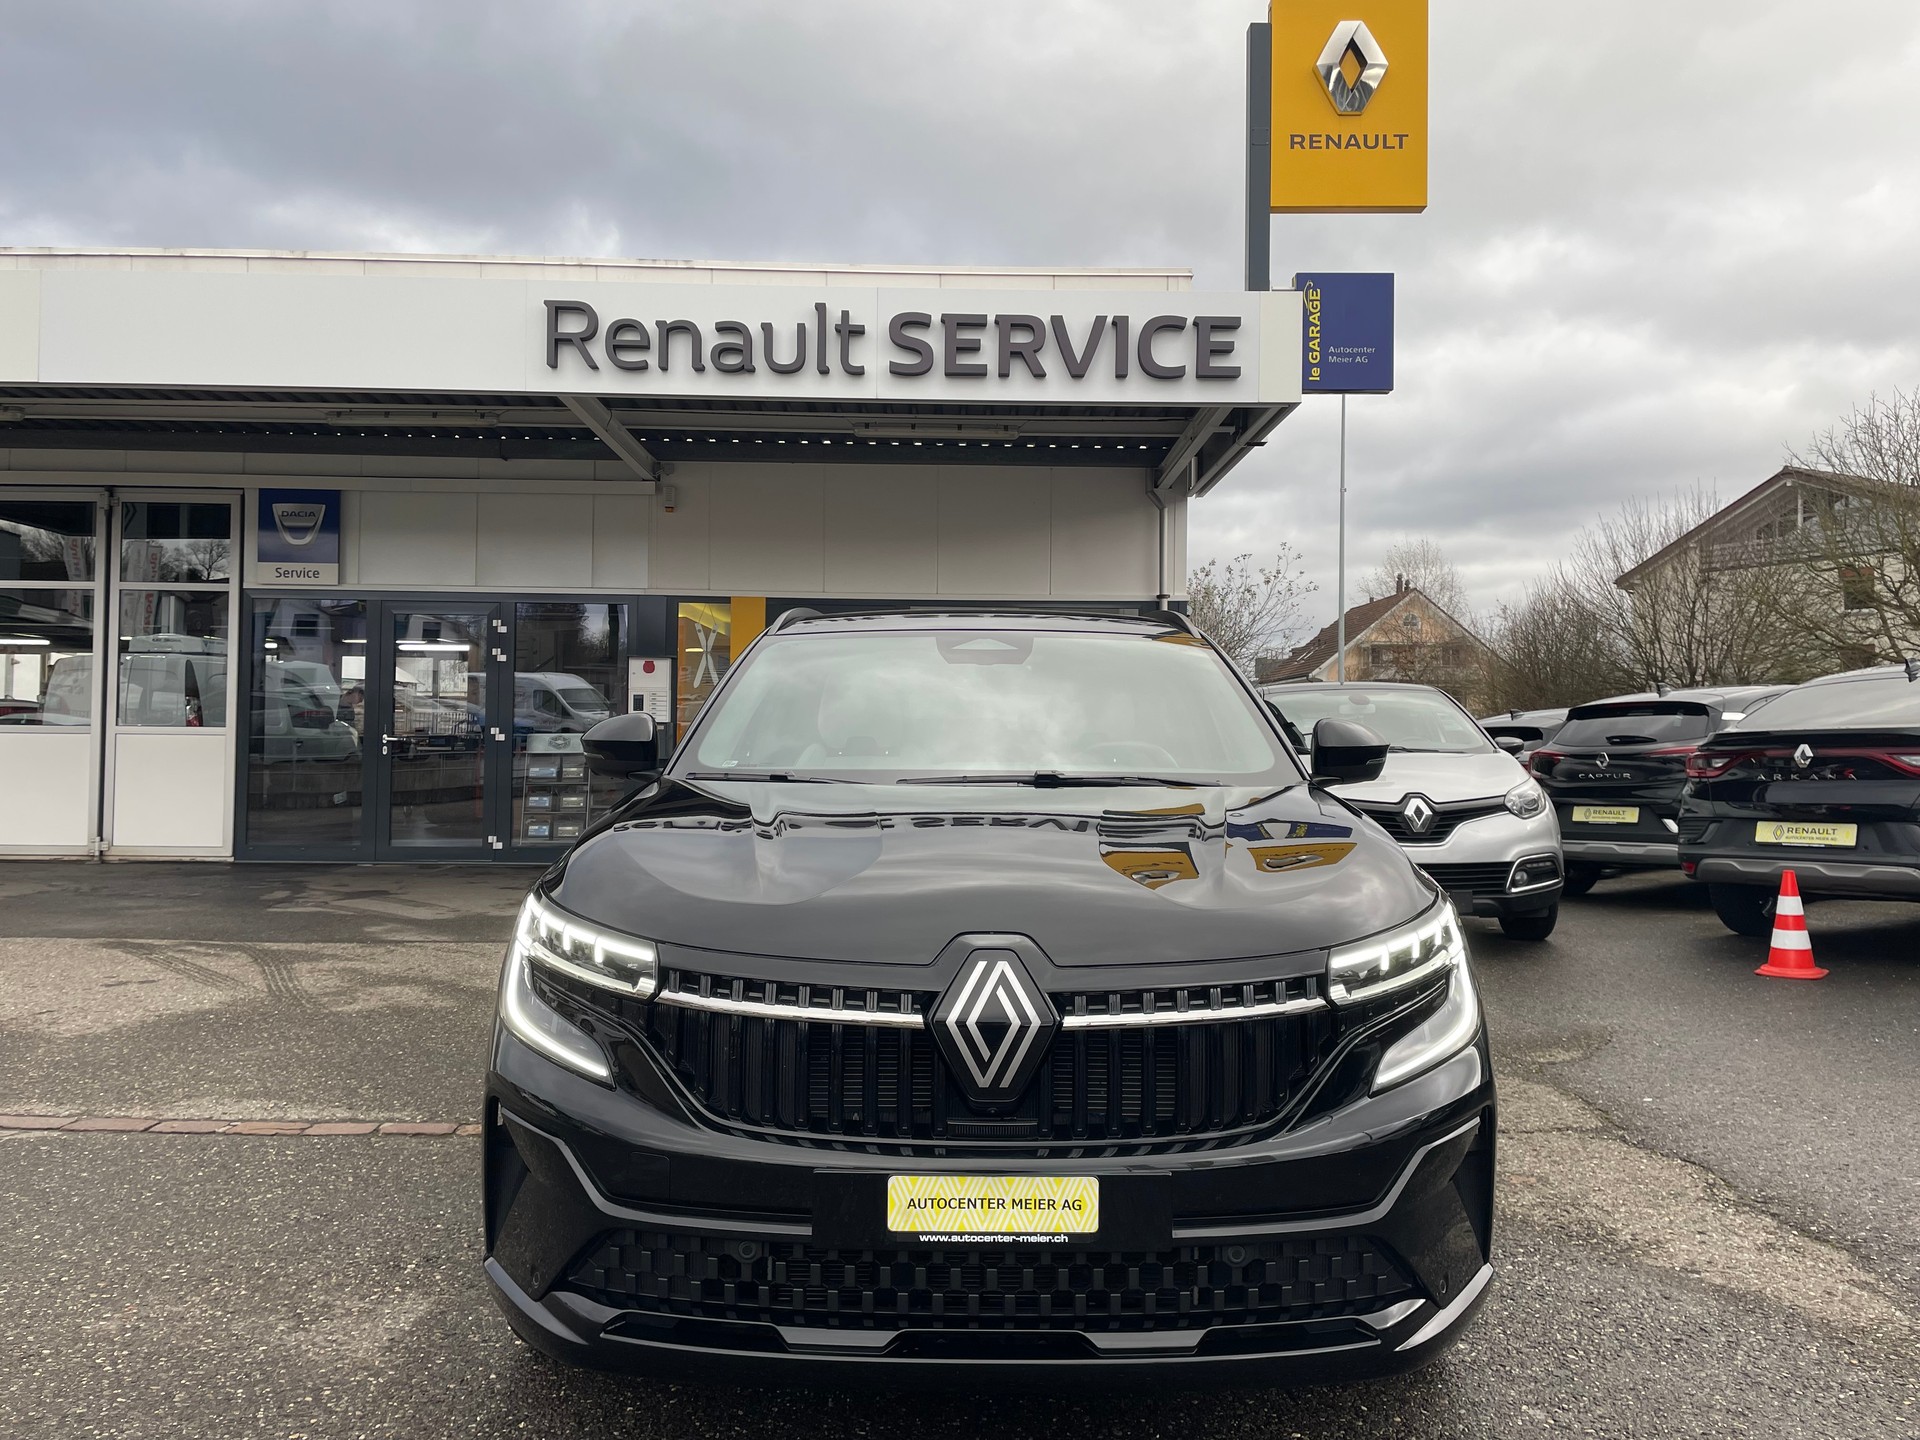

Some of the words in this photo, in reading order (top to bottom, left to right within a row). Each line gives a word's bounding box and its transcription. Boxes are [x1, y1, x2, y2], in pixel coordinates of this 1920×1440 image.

[1290, 134, 1409, 149] RENAULT
[1308, 288, 1321, 364] GARAGE
[543, 299, 866, 376] Renault
[888, 311, 1242, 380] SERVICE
[1328, 346, 1376, 354] Autocenter
[1328, 355, 1353, 363] Meier
[1355, 355, 1369, 363] AG
[1308, 367, 1321, 381] le
[281, 510, 316, 518] DACIA
[275, 567, 320, 579] Service
[1578, 772, 1632, 780] CAPTUR
[1757, 773, 1857, 781] ARKANA
[1787, 827, 1838, 835] RENAULT
[907, 1197, 1007, 1210] AUTOCENTER
[1011, 1198, 1056, 1211] MEIER
[1061, 1199, 1083, 1211] AG
[919, 1233, 1069, 1243] www.autocenter-meier.ch
